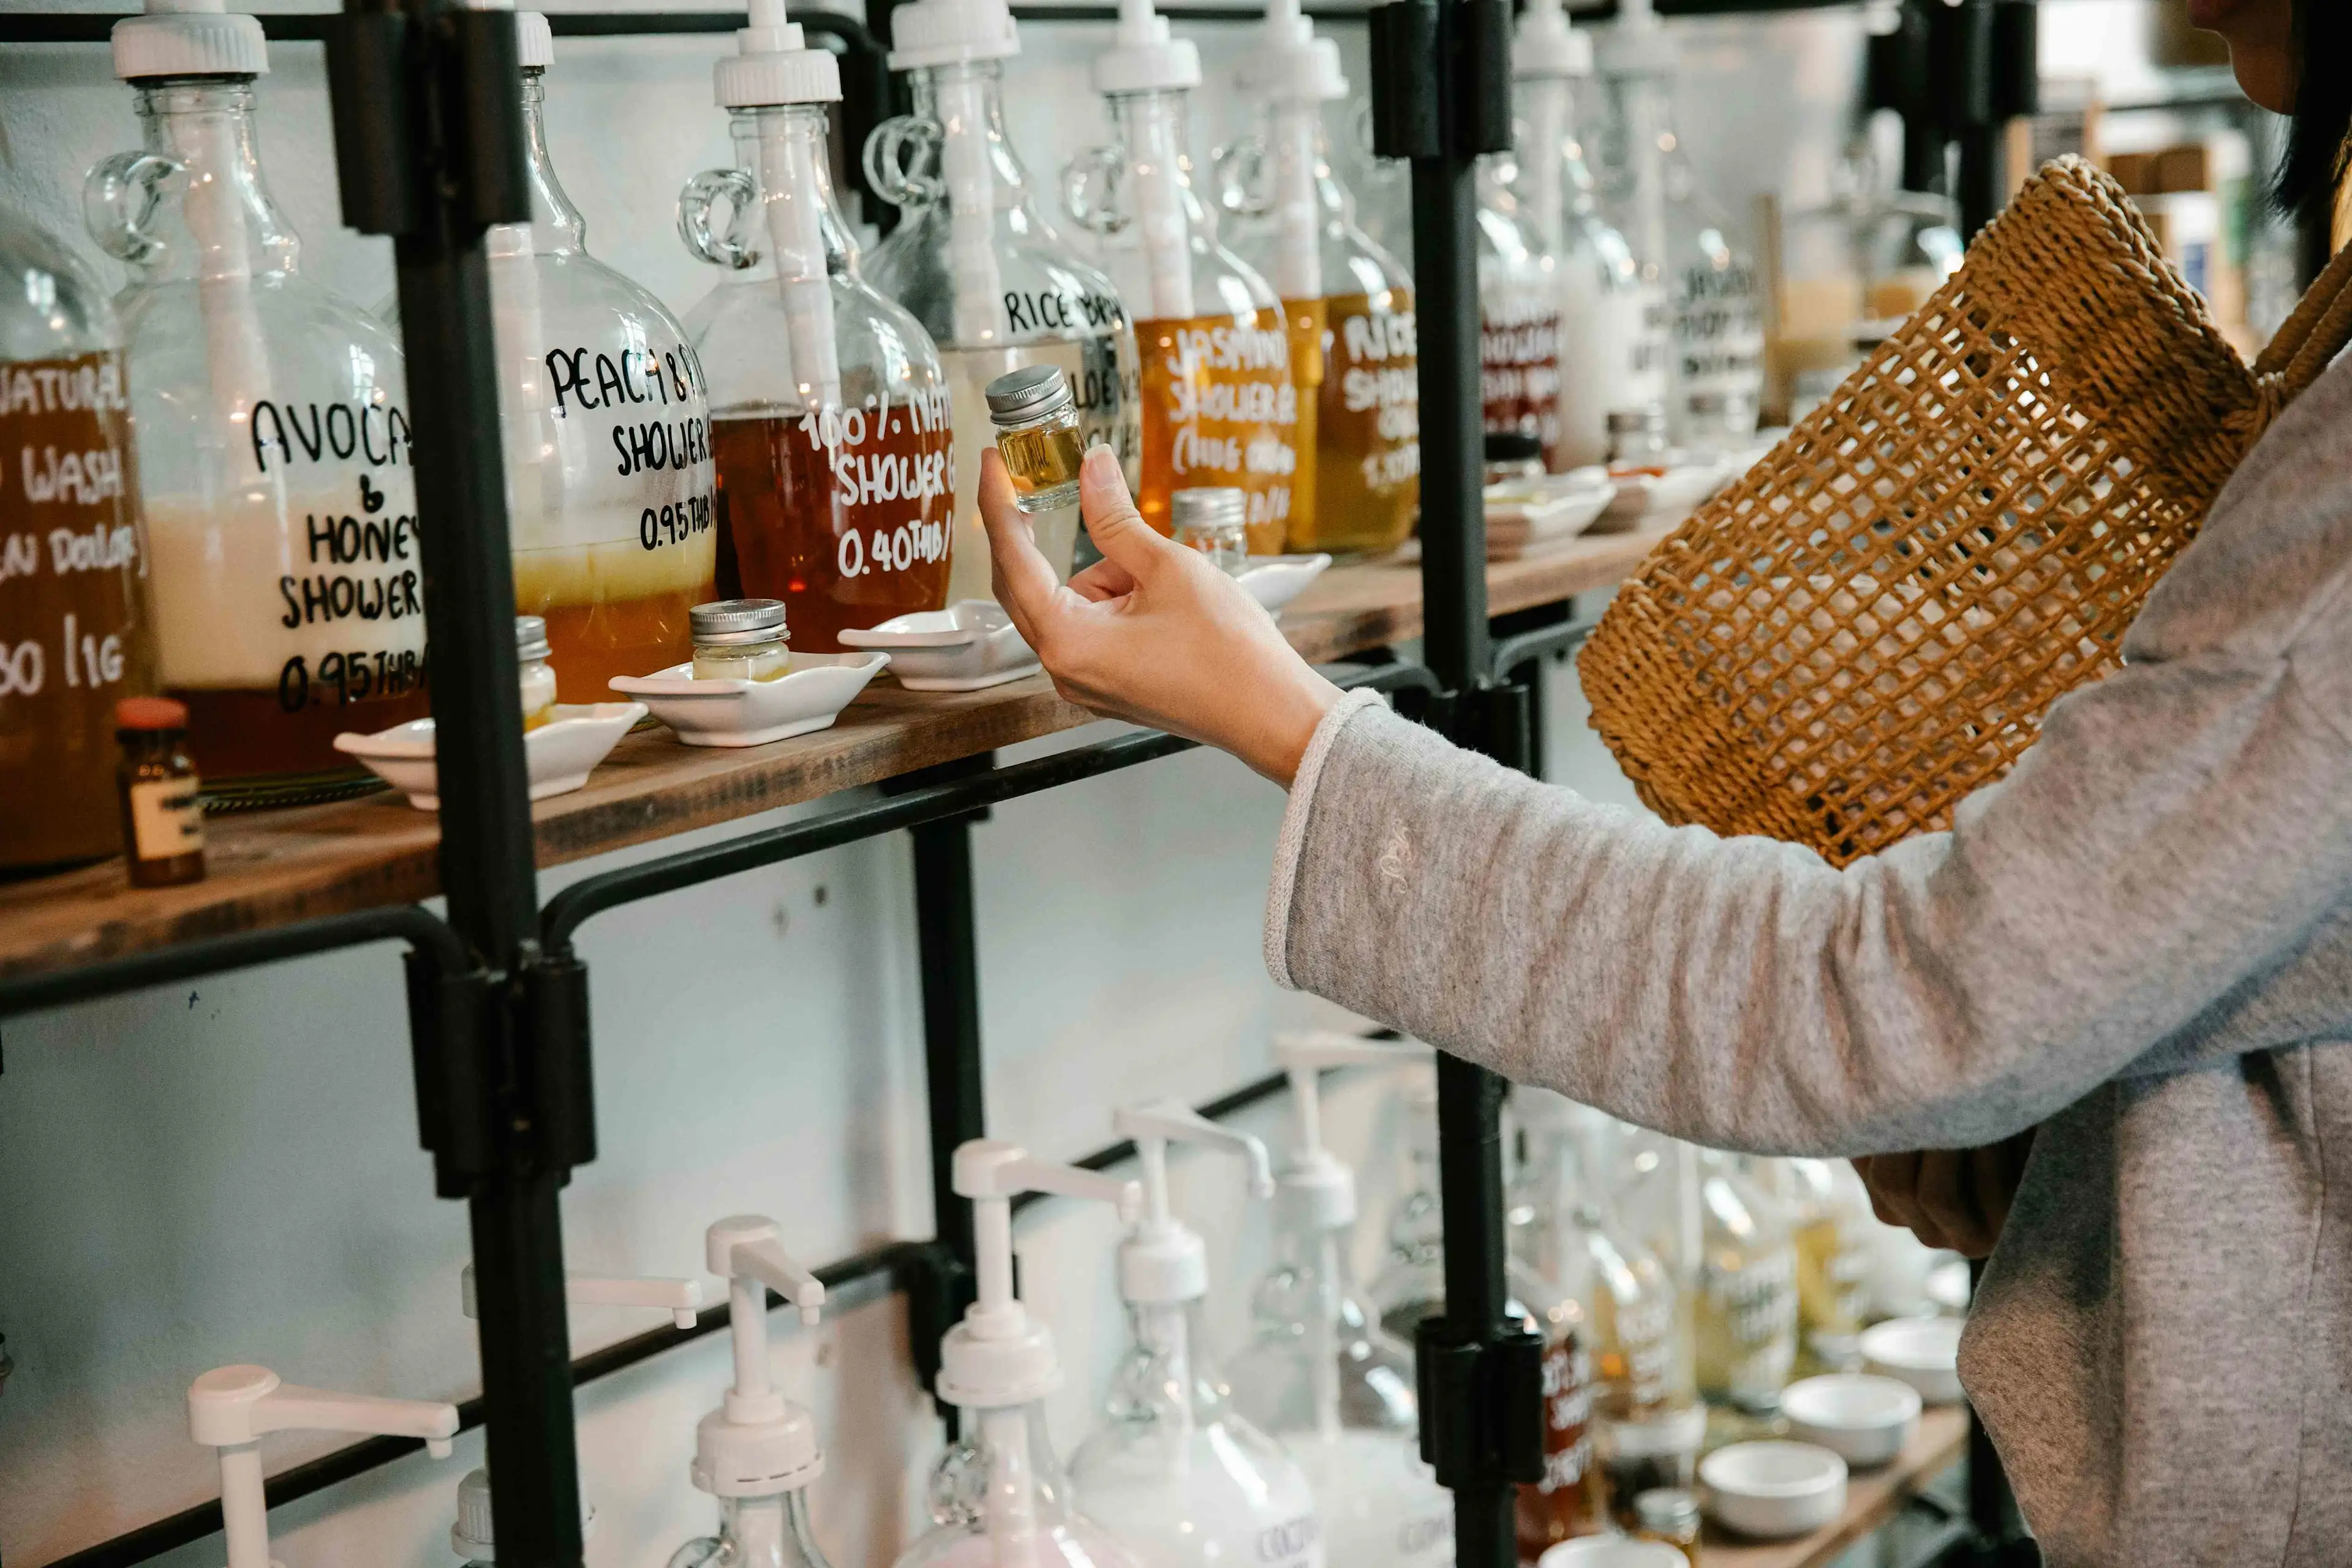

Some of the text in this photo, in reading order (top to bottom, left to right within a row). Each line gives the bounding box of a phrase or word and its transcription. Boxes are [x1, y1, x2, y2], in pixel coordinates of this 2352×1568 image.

[1005, 293, 1074, 333] RICE
[546, 347, 667, 418] PEACH
[909, 386, 953, 434] NAT
[1070, 369, 1120, 409] LOE
[21, 445, 124, 505] WASH
[612, 417, 707, 476] SHOWER
[836, 450, 944, 506] SHOWER
[279, 570, 421, 629] SHOWER
